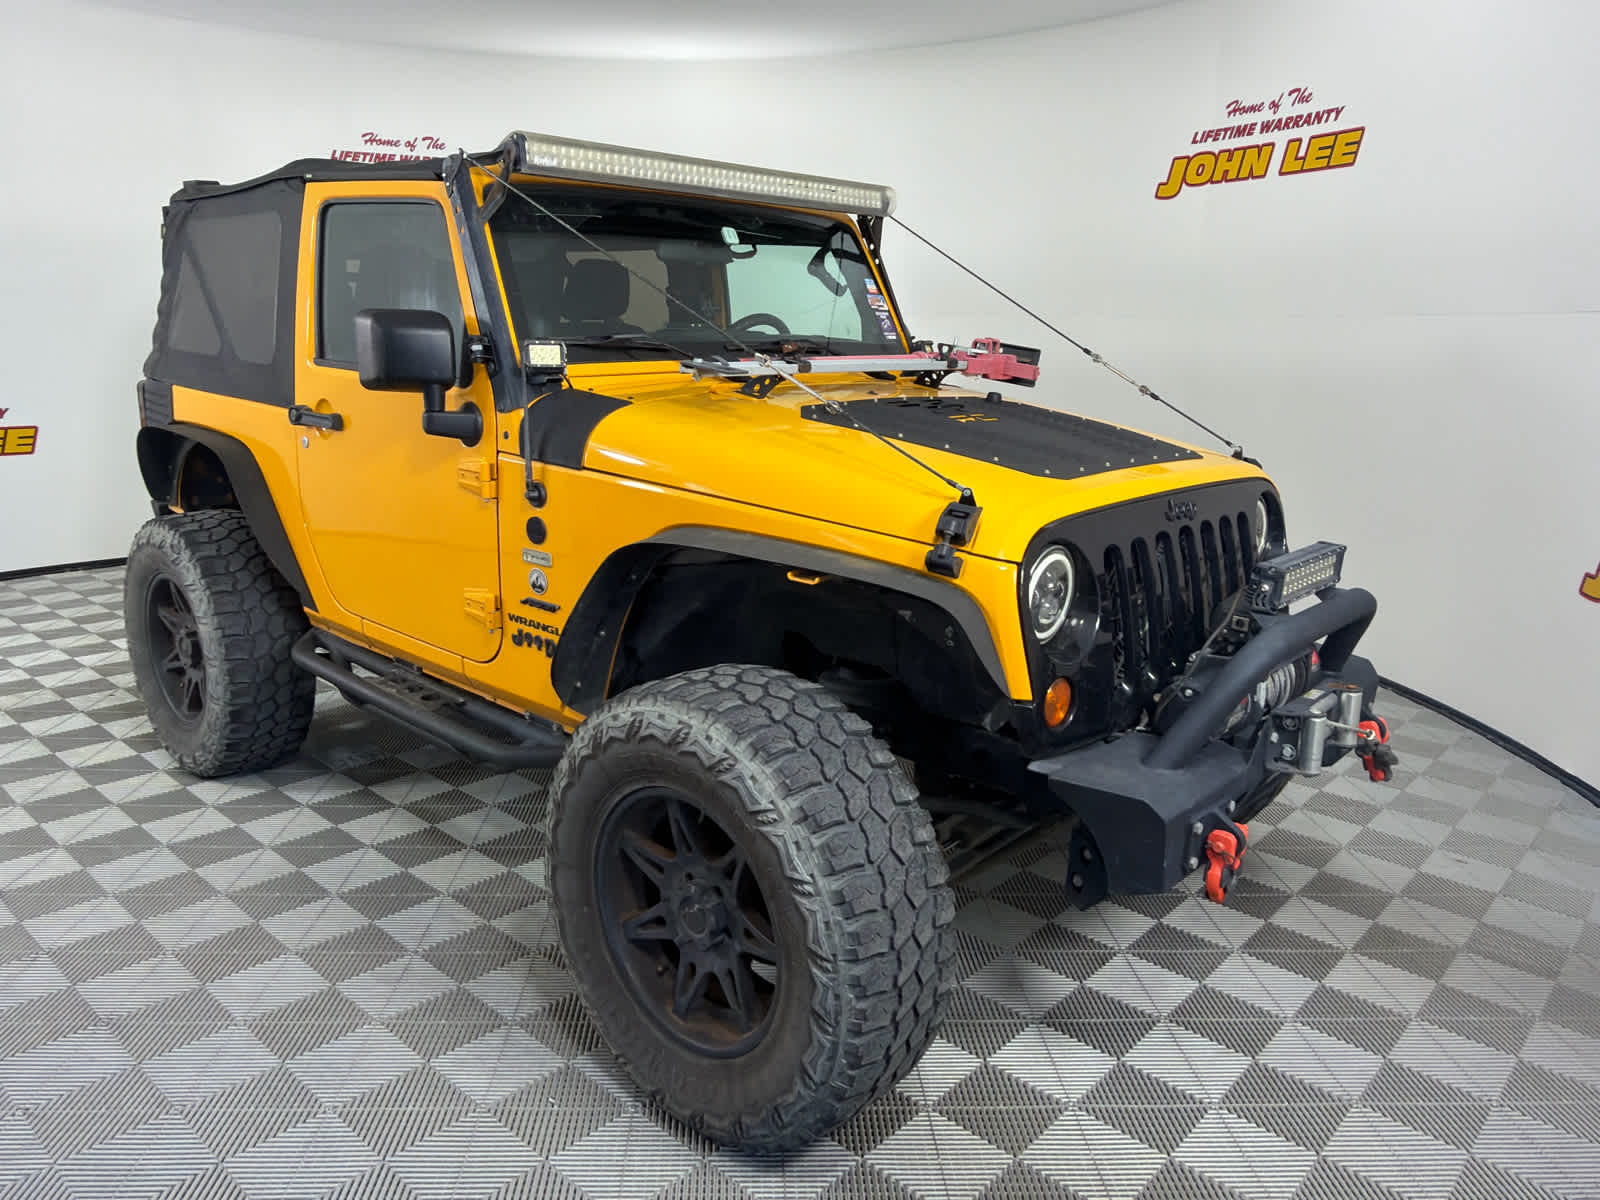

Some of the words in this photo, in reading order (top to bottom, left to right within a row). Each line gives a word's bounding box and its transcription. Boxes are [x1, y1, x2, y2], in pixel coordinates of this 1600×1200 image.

[1225, 100, 1265, 118] Home
[1268, 93, 1285, 115] of
[1287, 87, 1313, 106] The
[1191, 122, 1257, 145] LIFETIME
[1259, 105, 1346, 134] WARRANTY
[330, 149, 397, 163] LIFETIME
[361, 132, 401, 147] Home
[404, 137, 418, 152] of
[421, 136, 447, 150] The
[1155, 142, 1275, 200] JOHN
[1278, 126, 1366, 177] LEE
[507, 612, 561, 637] WRANGL
